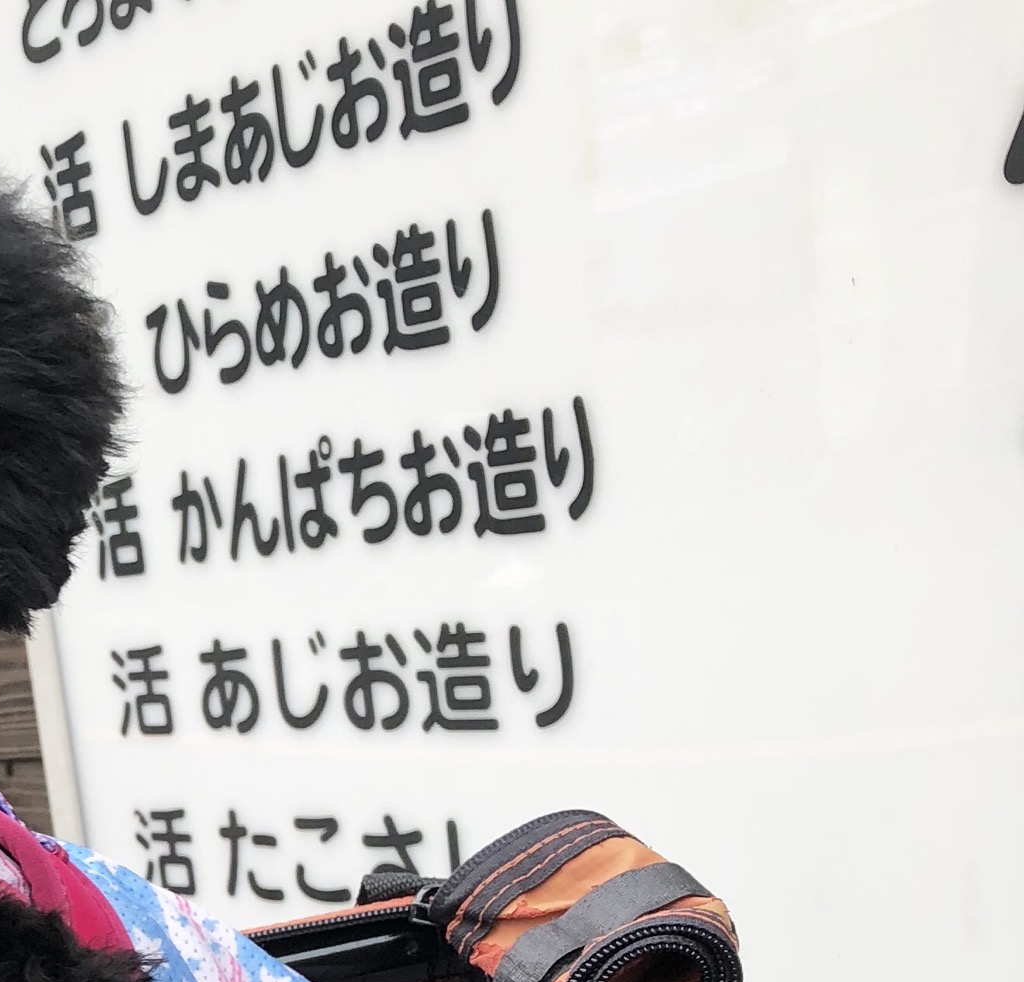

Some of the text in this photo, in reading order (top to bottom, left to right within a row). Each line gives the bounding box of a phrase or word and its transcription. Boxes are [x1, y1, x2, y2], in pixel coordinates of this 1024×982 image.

[40, 0, 520, 242] 活 しまあじお造り
[146, 209, 500, 394] ひらめお造り
[91, 396, 594, 580] 活 かんぱちお造り
[111, 622, 574, 736] 活 あじお造り
[134, 809, 196, 896] 活
